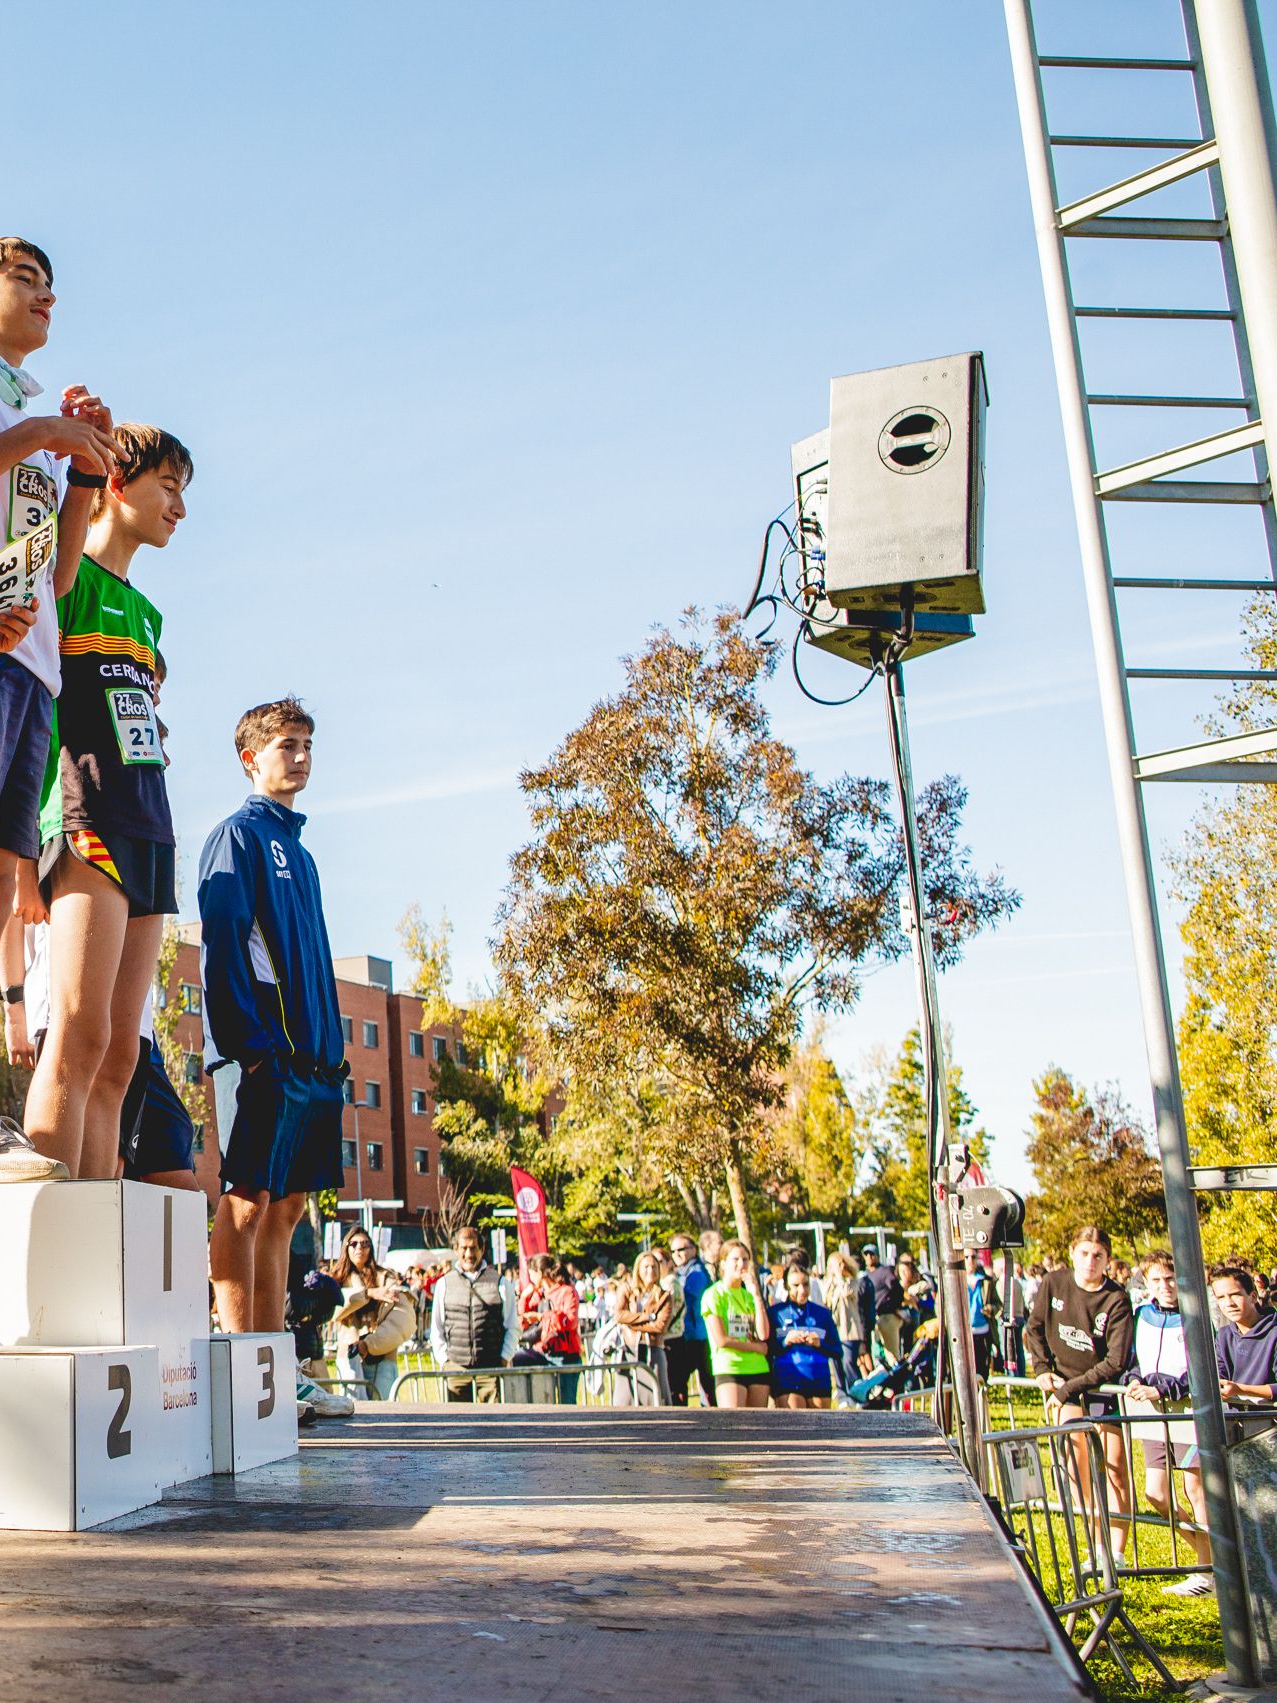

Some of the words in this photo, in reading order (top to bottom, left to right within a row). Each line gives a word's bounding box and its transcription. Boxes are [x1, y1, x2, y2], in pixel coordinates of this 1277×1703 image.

[19, 481, 48, 502] CROS
[26, 507, 46, 527] 3
[31, 533, 44, 570] CROS
[118, 702, 147, 716] CROS
[129, 727, 154, 745] 27
[162, 1361, 197, 1387] Diputació
[257, 1345, 276, 1420] 3
[163, 1389, 198, 1411] Barcelona
[106, 1364, 132, 1460] 2
